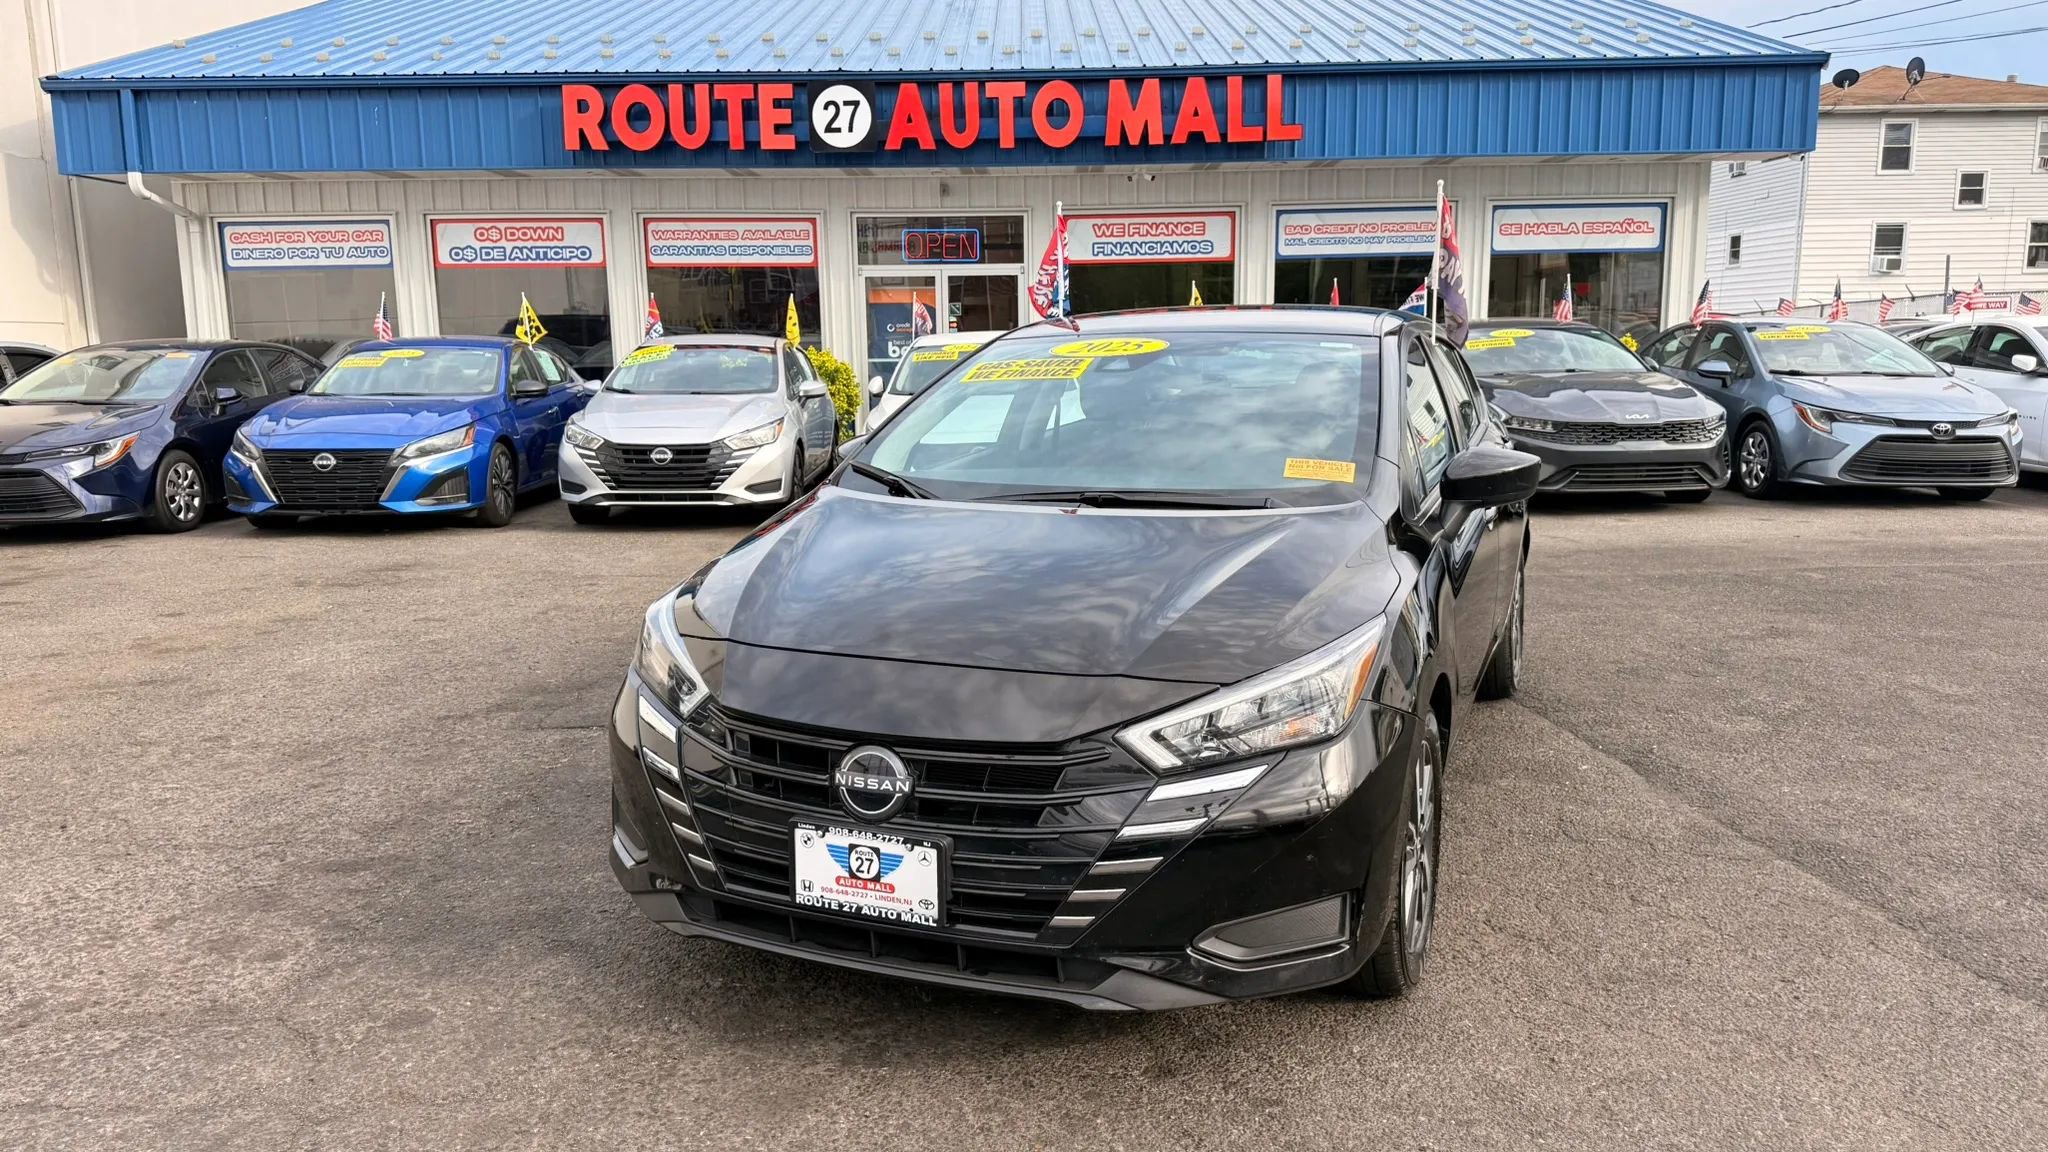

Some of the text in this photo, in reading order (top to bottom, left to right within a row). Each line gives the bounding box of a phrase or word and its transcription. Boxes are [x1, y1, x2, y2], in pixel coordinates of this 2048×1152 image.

[562, 74, 1303, 151] ROUTE 27 AUTO MALL
[1093, 221, 1206, 238] WE FINANCE
[1285, 224, 1312, 235] BAD
[1314, 224, 1357, 234] CREDIT
[1359, 223, 1380, 233] NO
[1500, 217, 1655, 235] SE HABLA ESPAÑOL
[230, 230, 384, 244] CASH FOR YOUR CAR
[505, 226, 564, 242] DOWN
[652, 229, 810, 241] WARRANTIES AVAILABLE
[1284, 238, 1307, 246] MAL
[1308, 237, 1348, 246] CREDITO
[1349, 237, 1364, 245] NO
[1365, 236, 1385, 245] HAY
[232, 246, 389, 260] DINERO POR TU AUTO
[650, 245, 813, 256] GARANTIAS DISPONIBLES
[905, 232, 977, 259] OPEN
[1092, 240, 1214, 256] FINANCIAMOS
[480, 247, 506, 261] DE
[508, 246, 593, 261] ANTICIPO
[1065, 341, 1153, 353] 2025
[966, 368, 1081, 380] WE FINANCE
[835, 772, 910, 792] NISSAN
[797, 822, 816, 830] Linden
[829, 826, 905, 845] 908-648-2727
[854, 849, 875, 858] ROUTE
[855, 856, 874, 875] 27
[820, 886, 869, 898] 908-648-2727
[838, 878, 892, 893] AUTO MALL
[796, 894, 938, 927] ROUTE 27 AUTO MALL
